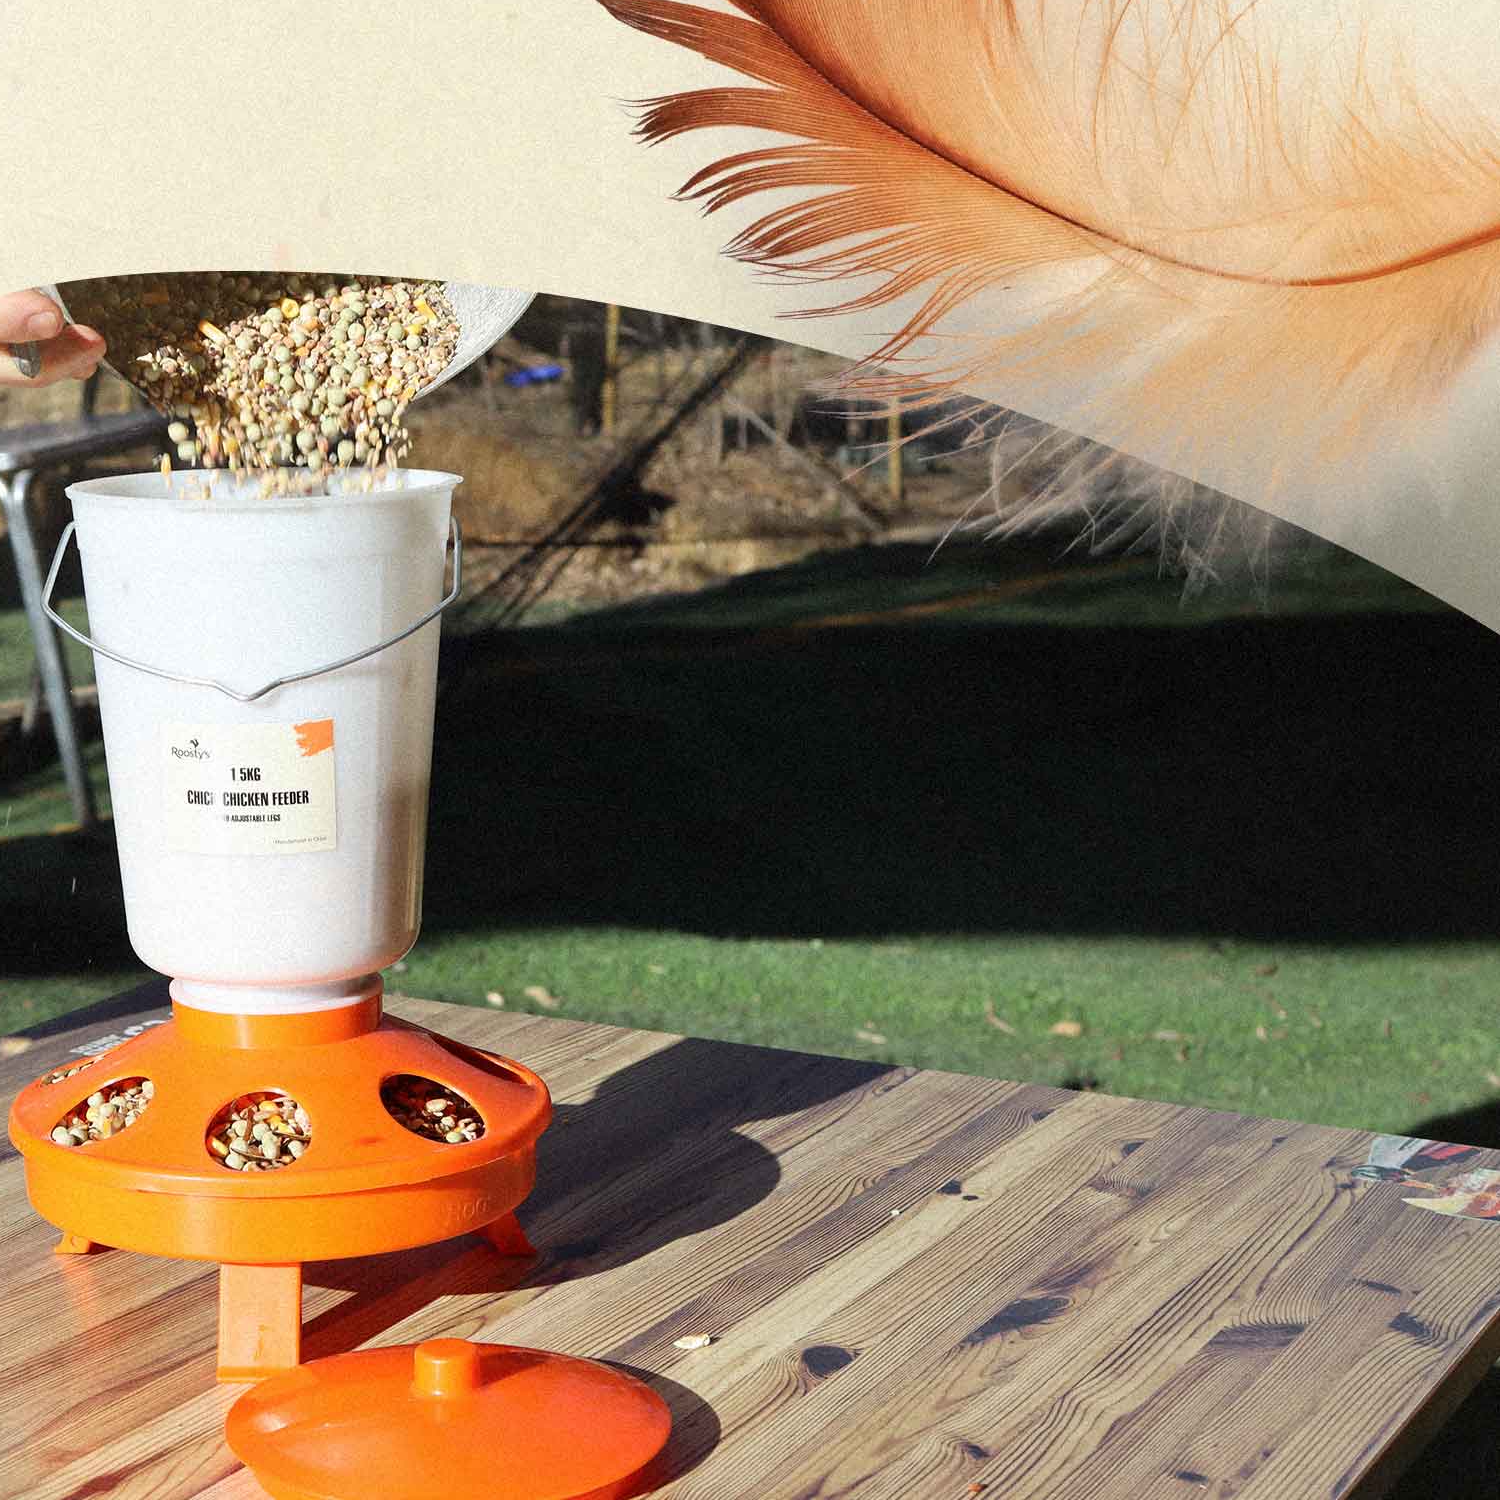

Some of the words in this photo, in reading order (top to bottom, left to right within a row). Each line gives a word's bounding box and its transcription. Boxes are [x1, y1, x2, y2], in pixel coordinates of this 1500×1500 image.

[171, 745, 211, 760] Roosty's
[272, 790, 310, 805] FEEDER
[231, 814, 265, 823] ADJUSTABLE
[267, 813, 281, 822] LEGS
